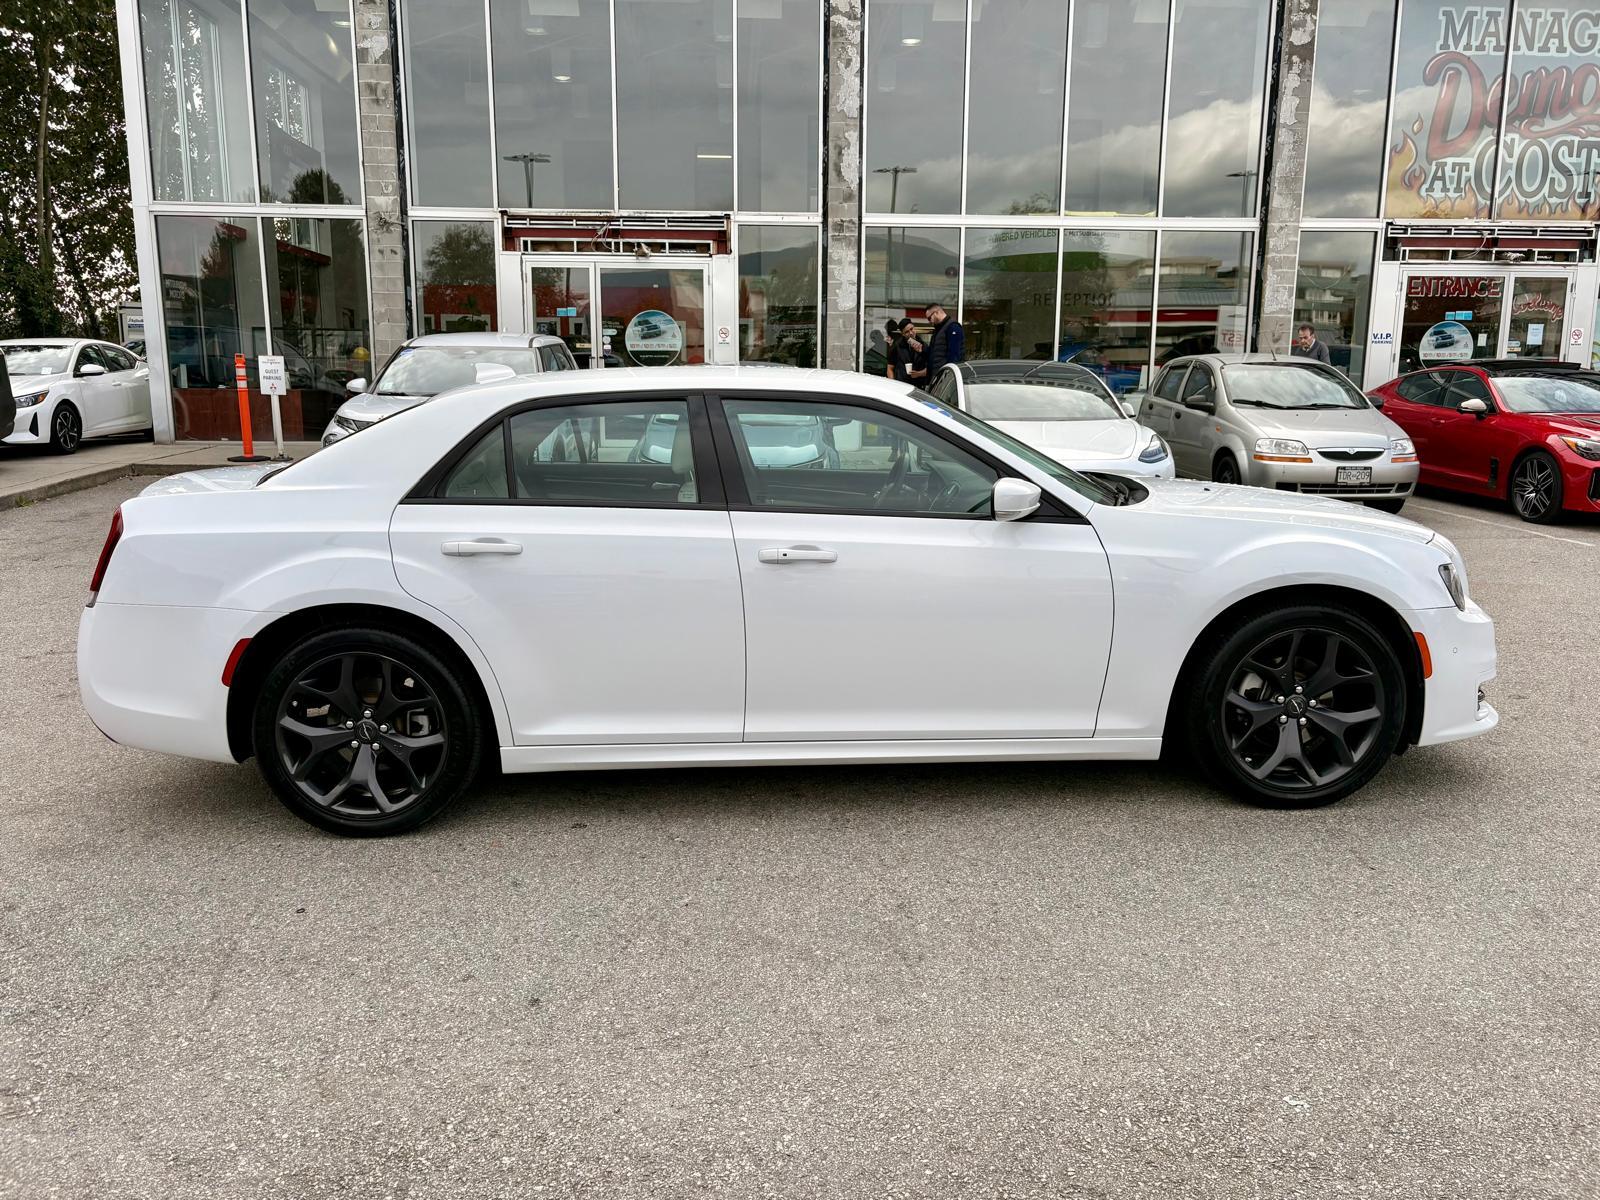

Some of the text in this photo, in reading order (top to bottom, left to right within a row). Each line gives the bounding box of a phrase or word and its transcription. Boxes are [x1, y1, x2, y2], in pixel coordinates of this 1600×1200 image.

[1438, 8, 1600, 54] MANAG
[1425, 137, 1600, 201] AT COST
[1021, 229, 1057, 240] VEHICLES
[1407, 275, 1503, 297] ENTRANCE
[1032, 292, 1113, 307] REEPTIO
